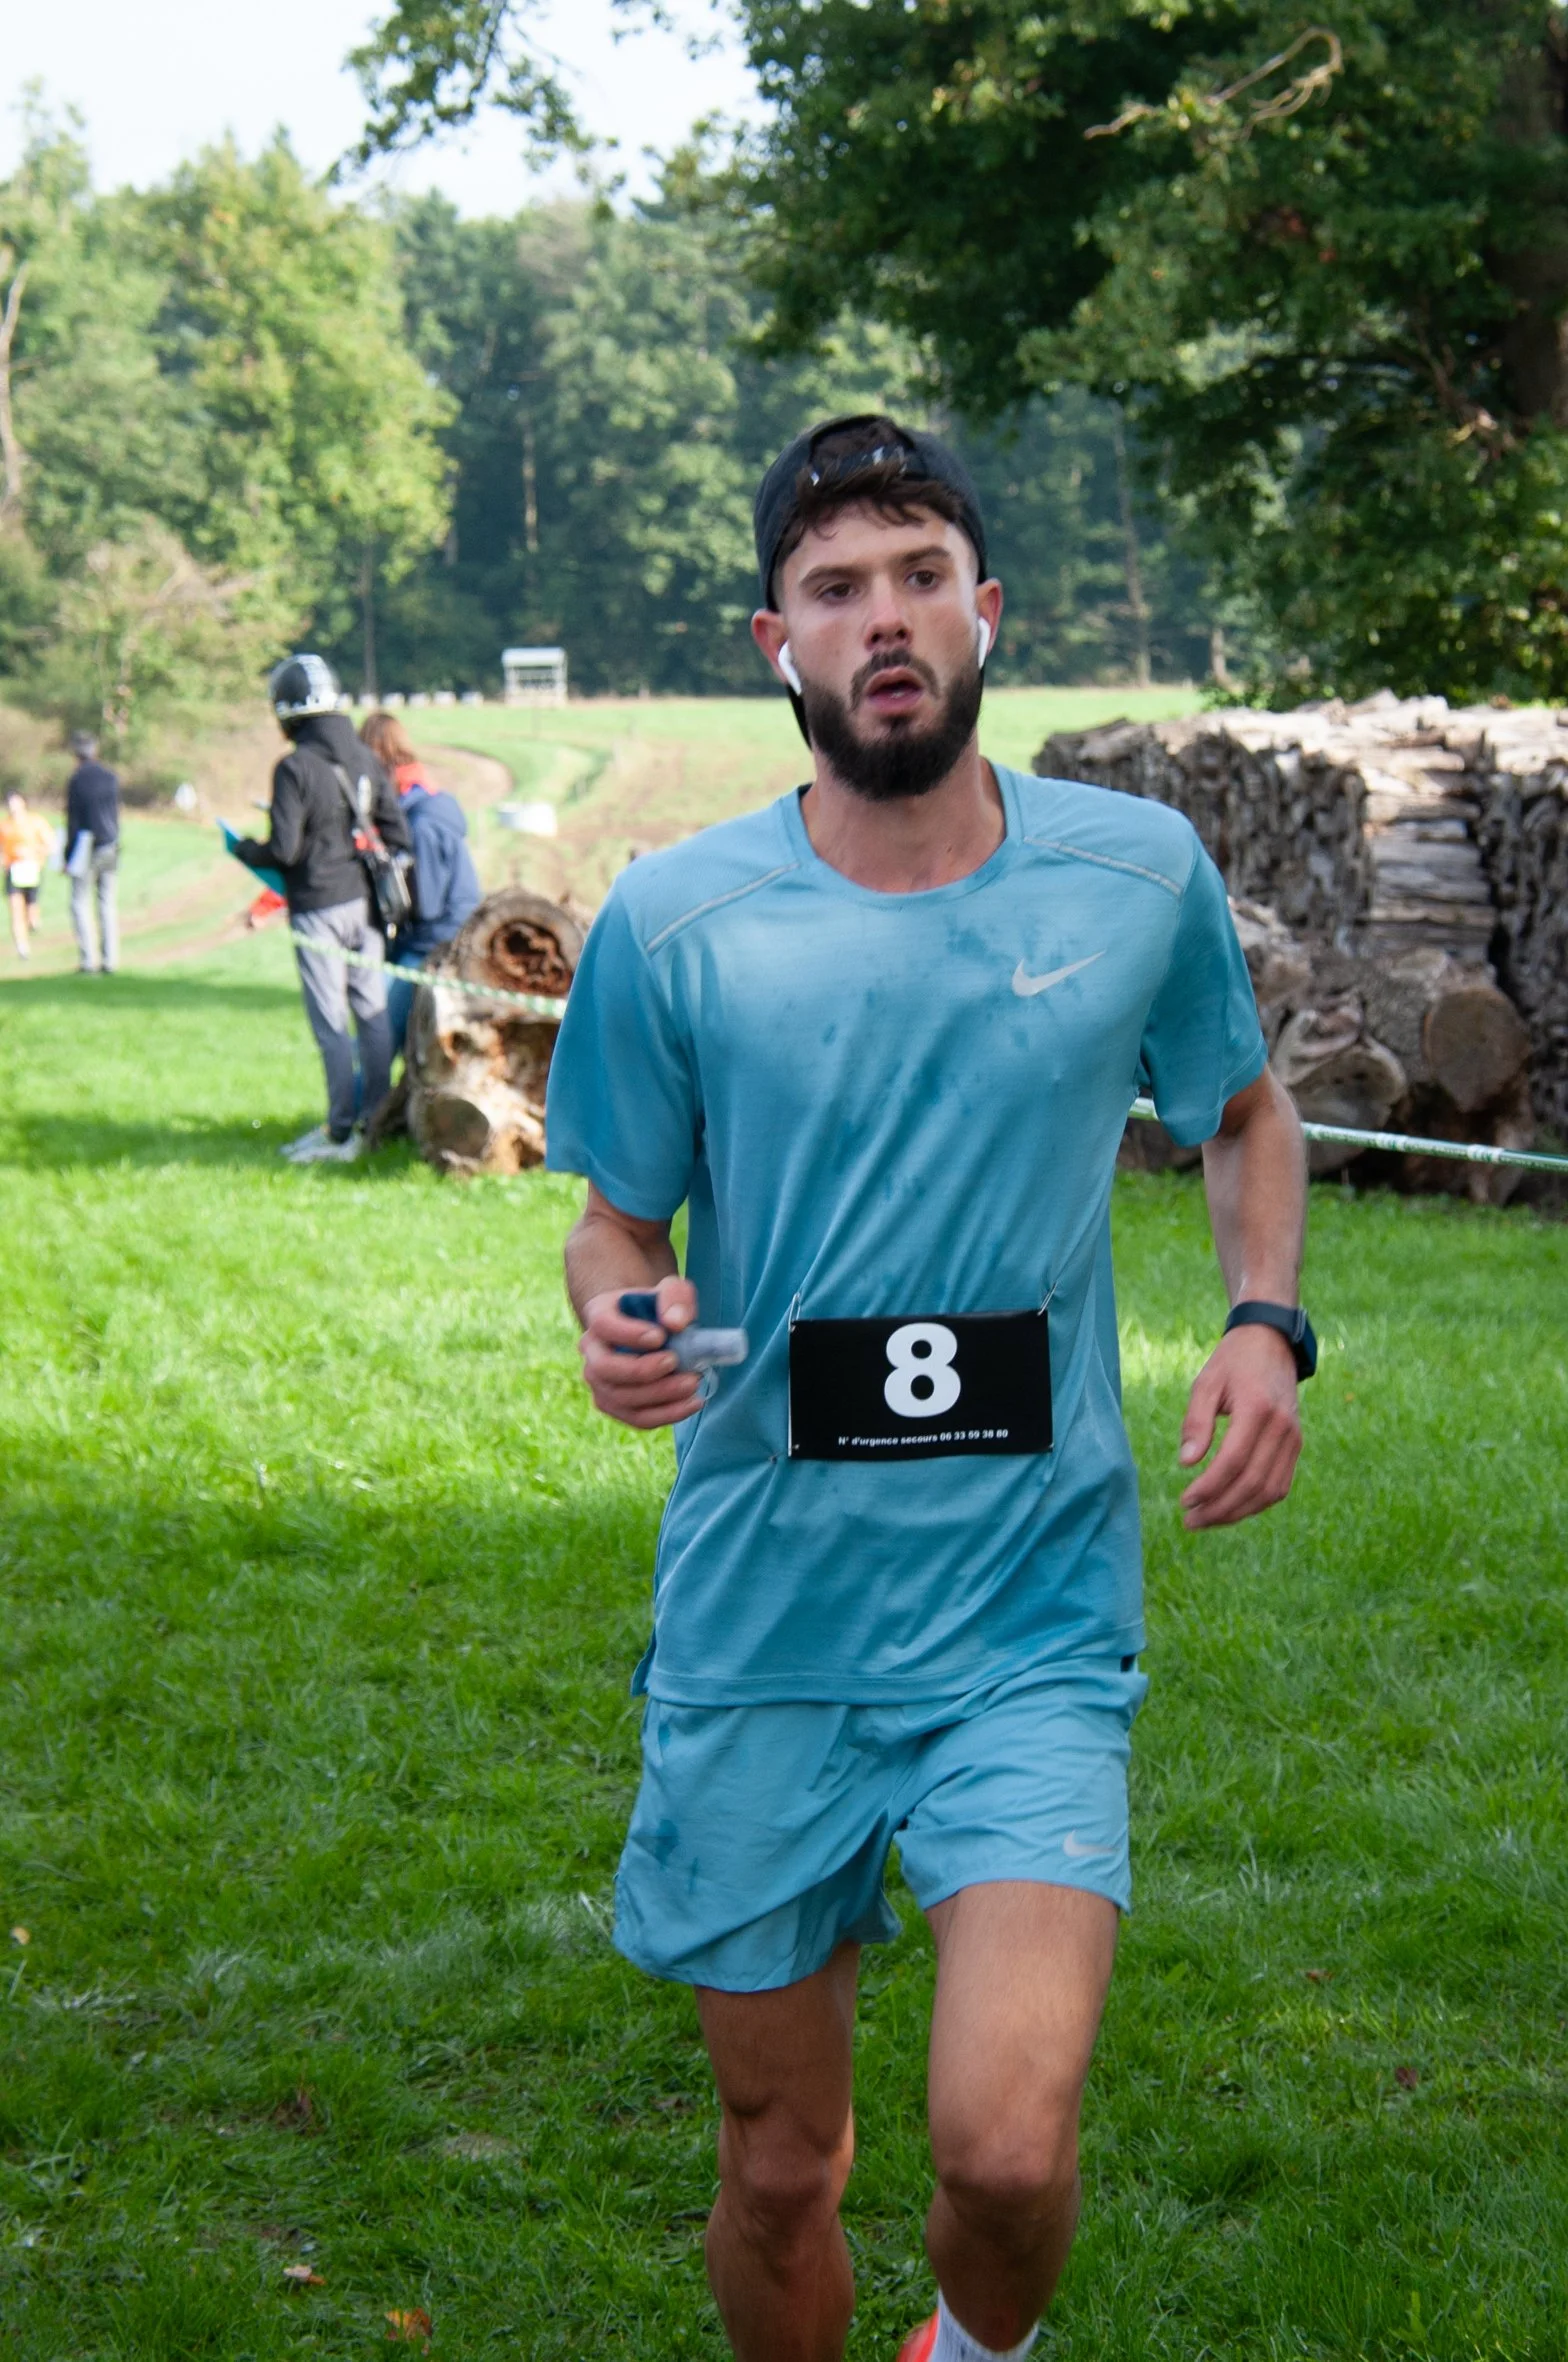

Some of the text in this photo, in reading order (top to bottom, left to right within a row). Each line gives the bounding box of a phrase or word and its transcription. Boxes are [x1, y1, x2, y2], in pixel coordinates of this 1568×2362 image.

[884, 1322, 962, 1418] 8
[851, 1436, 899, 1447] d'urgence
[900, 1434, 937, 1445] secours
[939, 1432, 953, 1442] 06
[953, 1430, 966, 1441] 33
